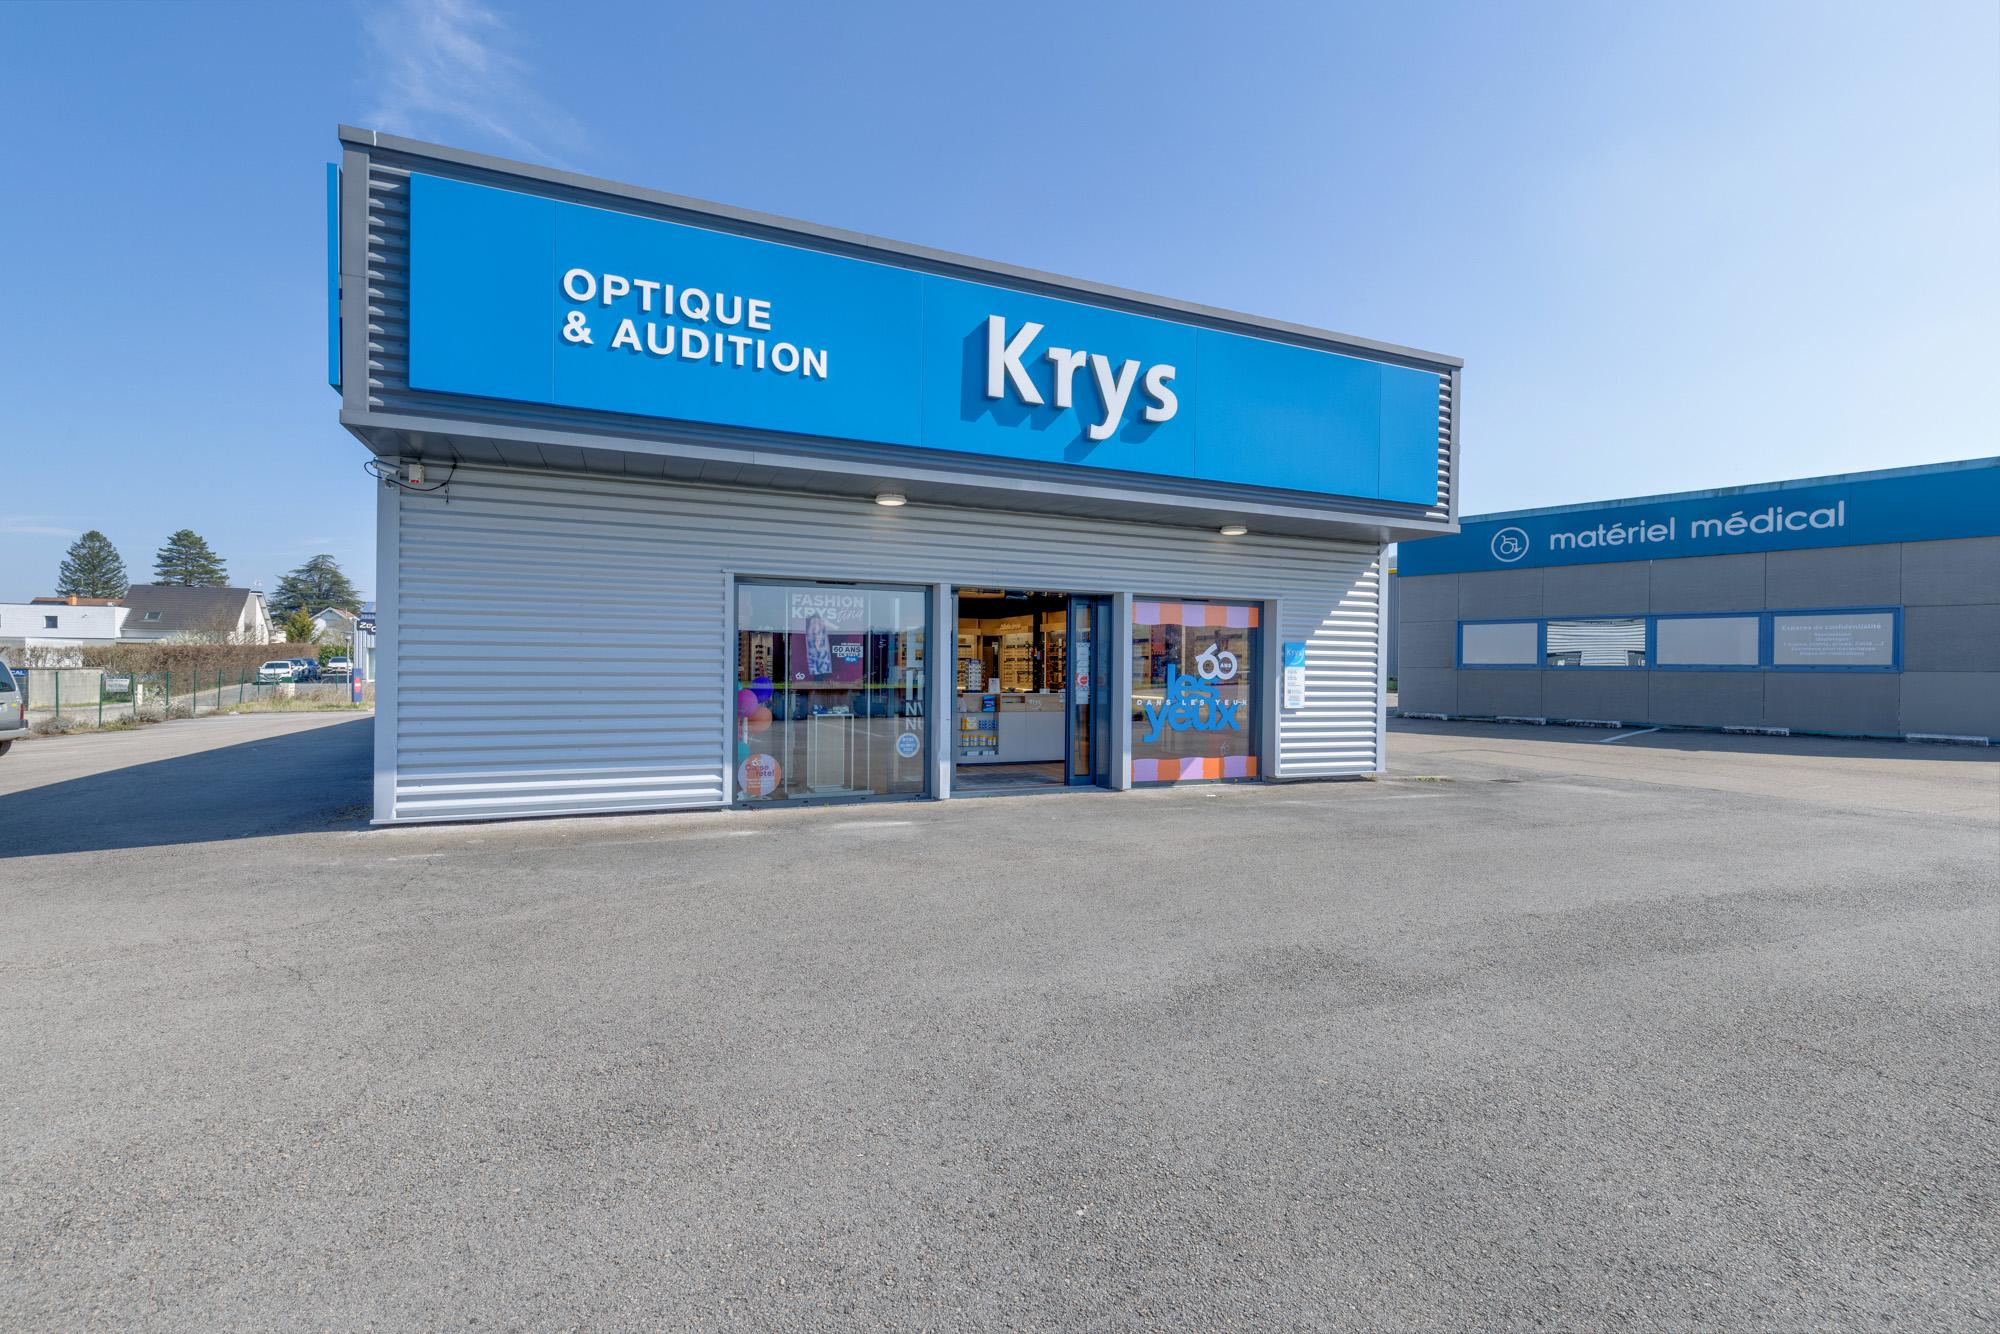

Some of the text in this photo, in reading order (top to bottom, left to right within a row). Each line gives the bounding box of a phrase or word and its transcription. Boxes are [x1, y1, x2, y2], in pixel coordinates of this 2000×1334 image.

[563, 268, 772, 331] OPTIQUE
[563, 311, 829, 380] & AUDITION
[986, 314, 1178, 440] Krys
[1550, 500, 1845, 551] matériel médical
[792, 593, 864, 608] FASHION
[1167, 664, 1220, 701] les
[1195, 643, 1238, 680] 60
[1143, 701, 1240, 743] yeux
